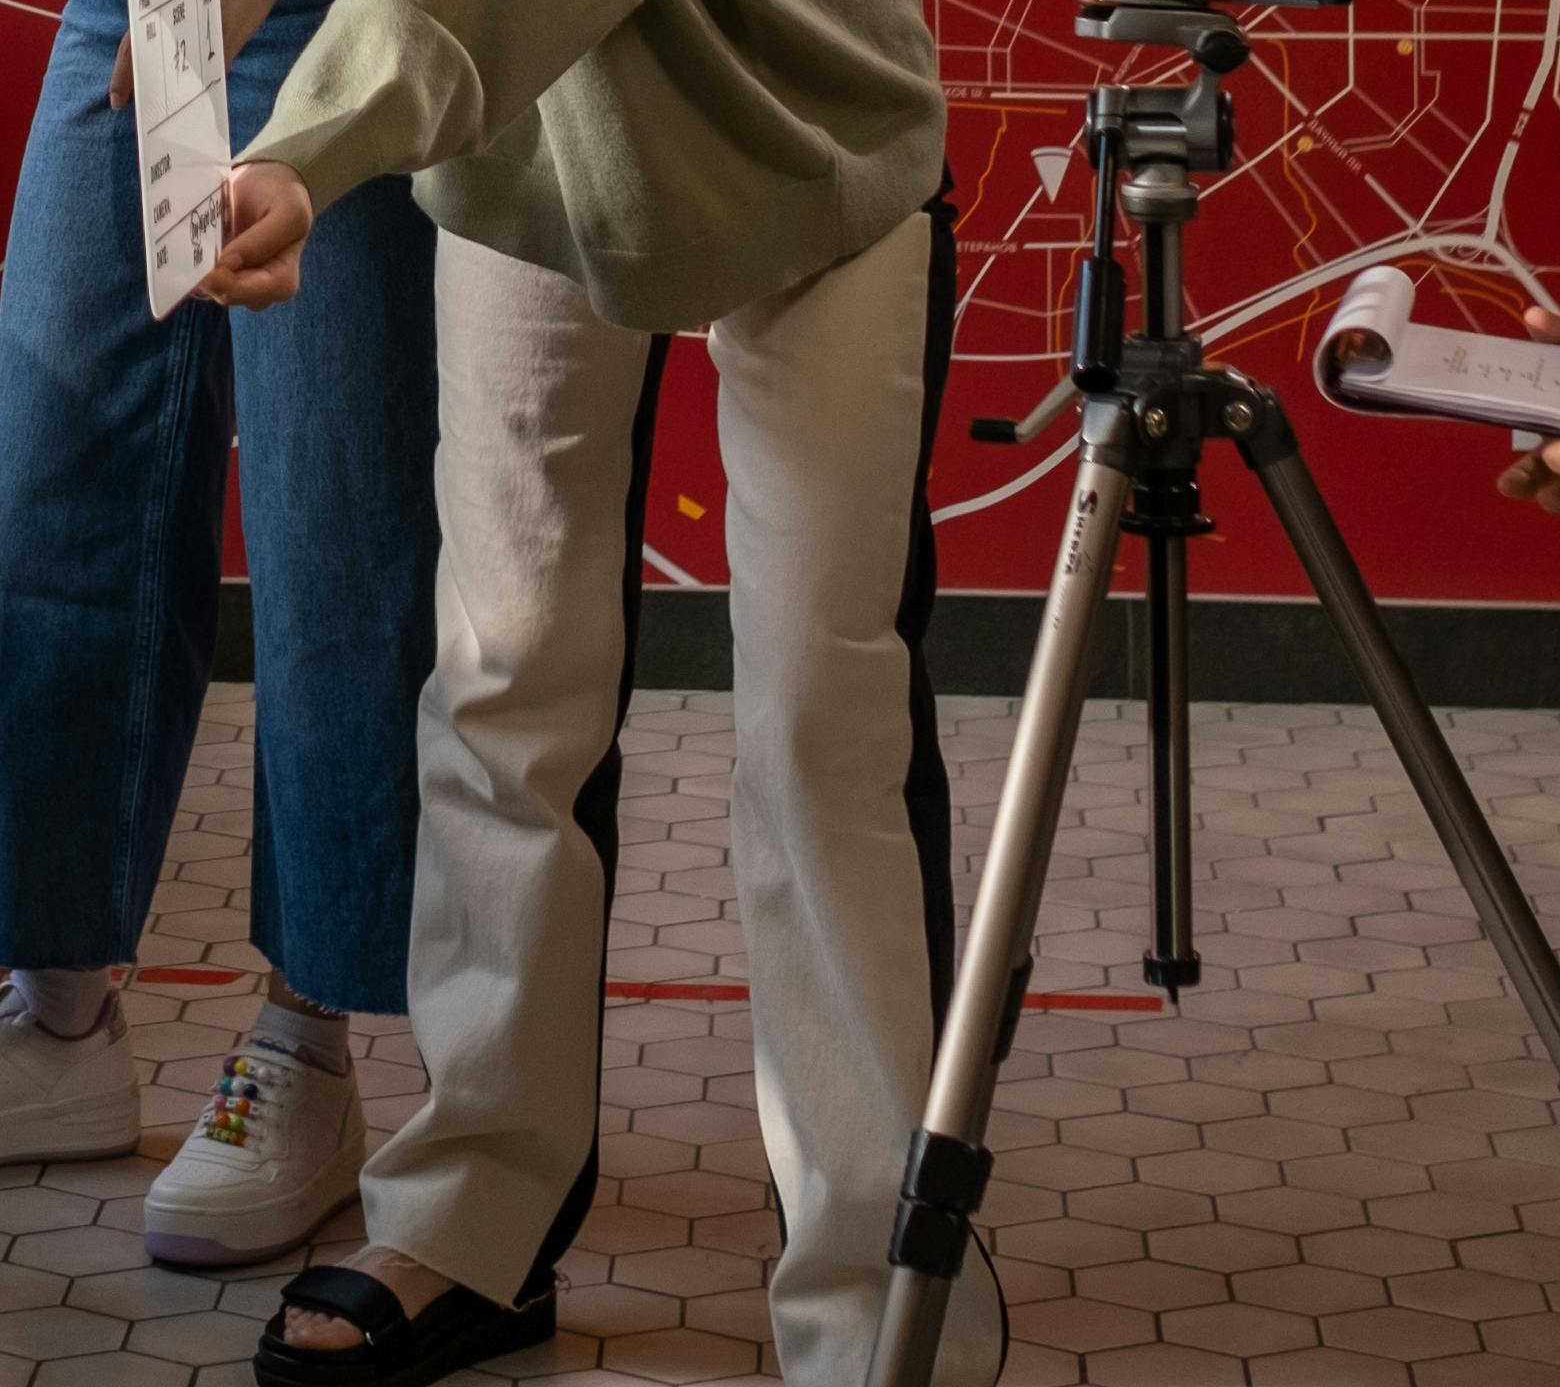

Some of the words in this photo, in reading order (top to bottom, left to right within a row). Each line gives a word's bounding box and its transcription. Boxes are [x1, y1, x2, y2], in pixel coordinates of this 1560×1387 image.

[172, 0, 186, 26] SCENE
[1304, 116, 1351, 161] ДАЧНЫЙ
[954, 240, 1018, 254] ЕТЕРАНОВ
